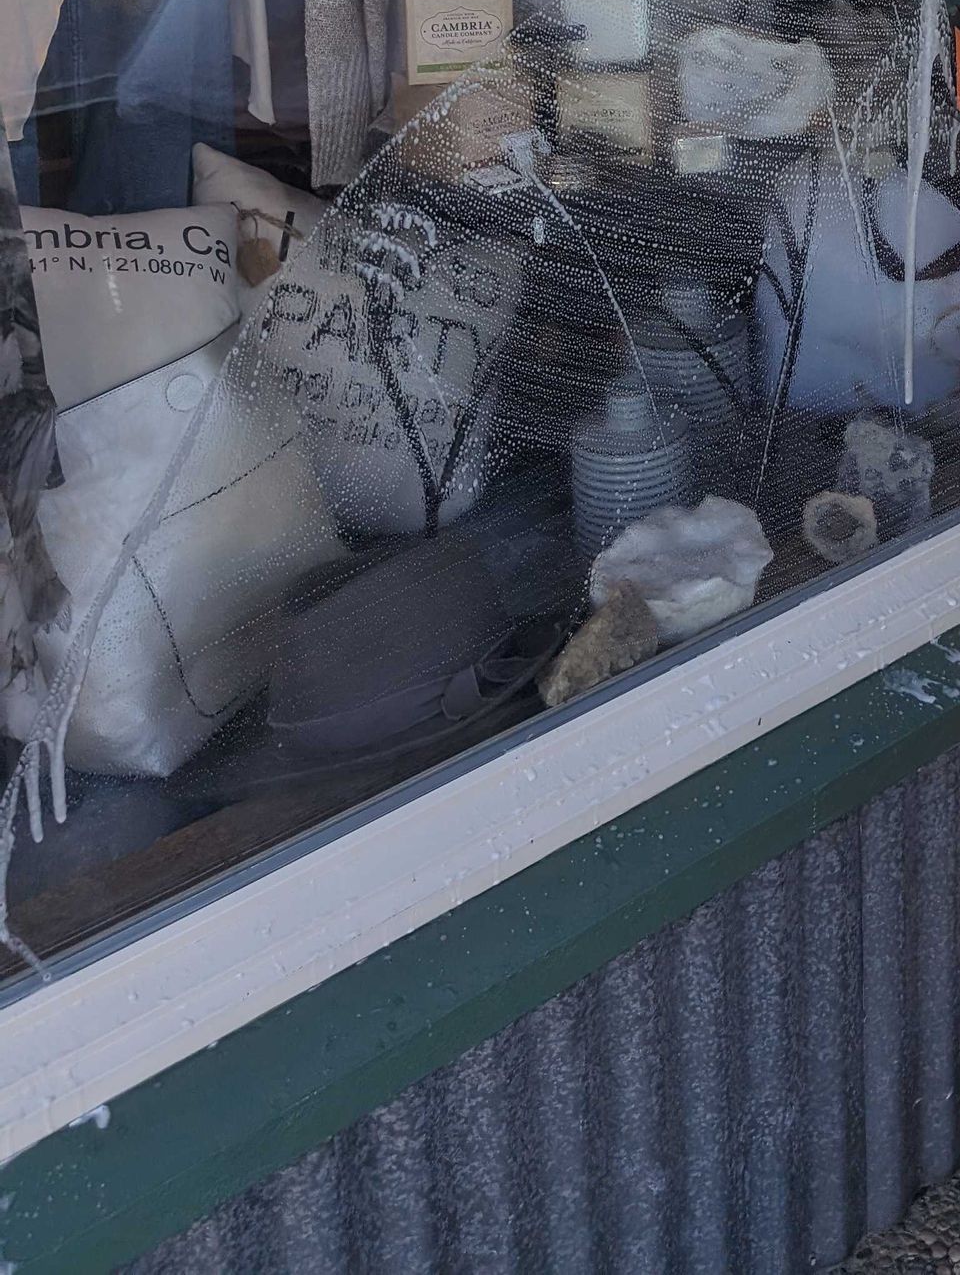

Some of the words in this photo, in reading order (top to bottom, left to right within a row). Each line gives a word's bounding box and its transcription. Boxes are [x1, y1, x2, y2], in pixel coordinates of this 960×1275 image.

[431, 21, 492, 33] CAMBRIA
[24, 223, 164, 255] mbria,
[182, 225, 232, 268] Ca
[69, 256, 93, 273] N,
[102, 256, 203, 277] 121.0807°
[209, 265, 226, 285] W
